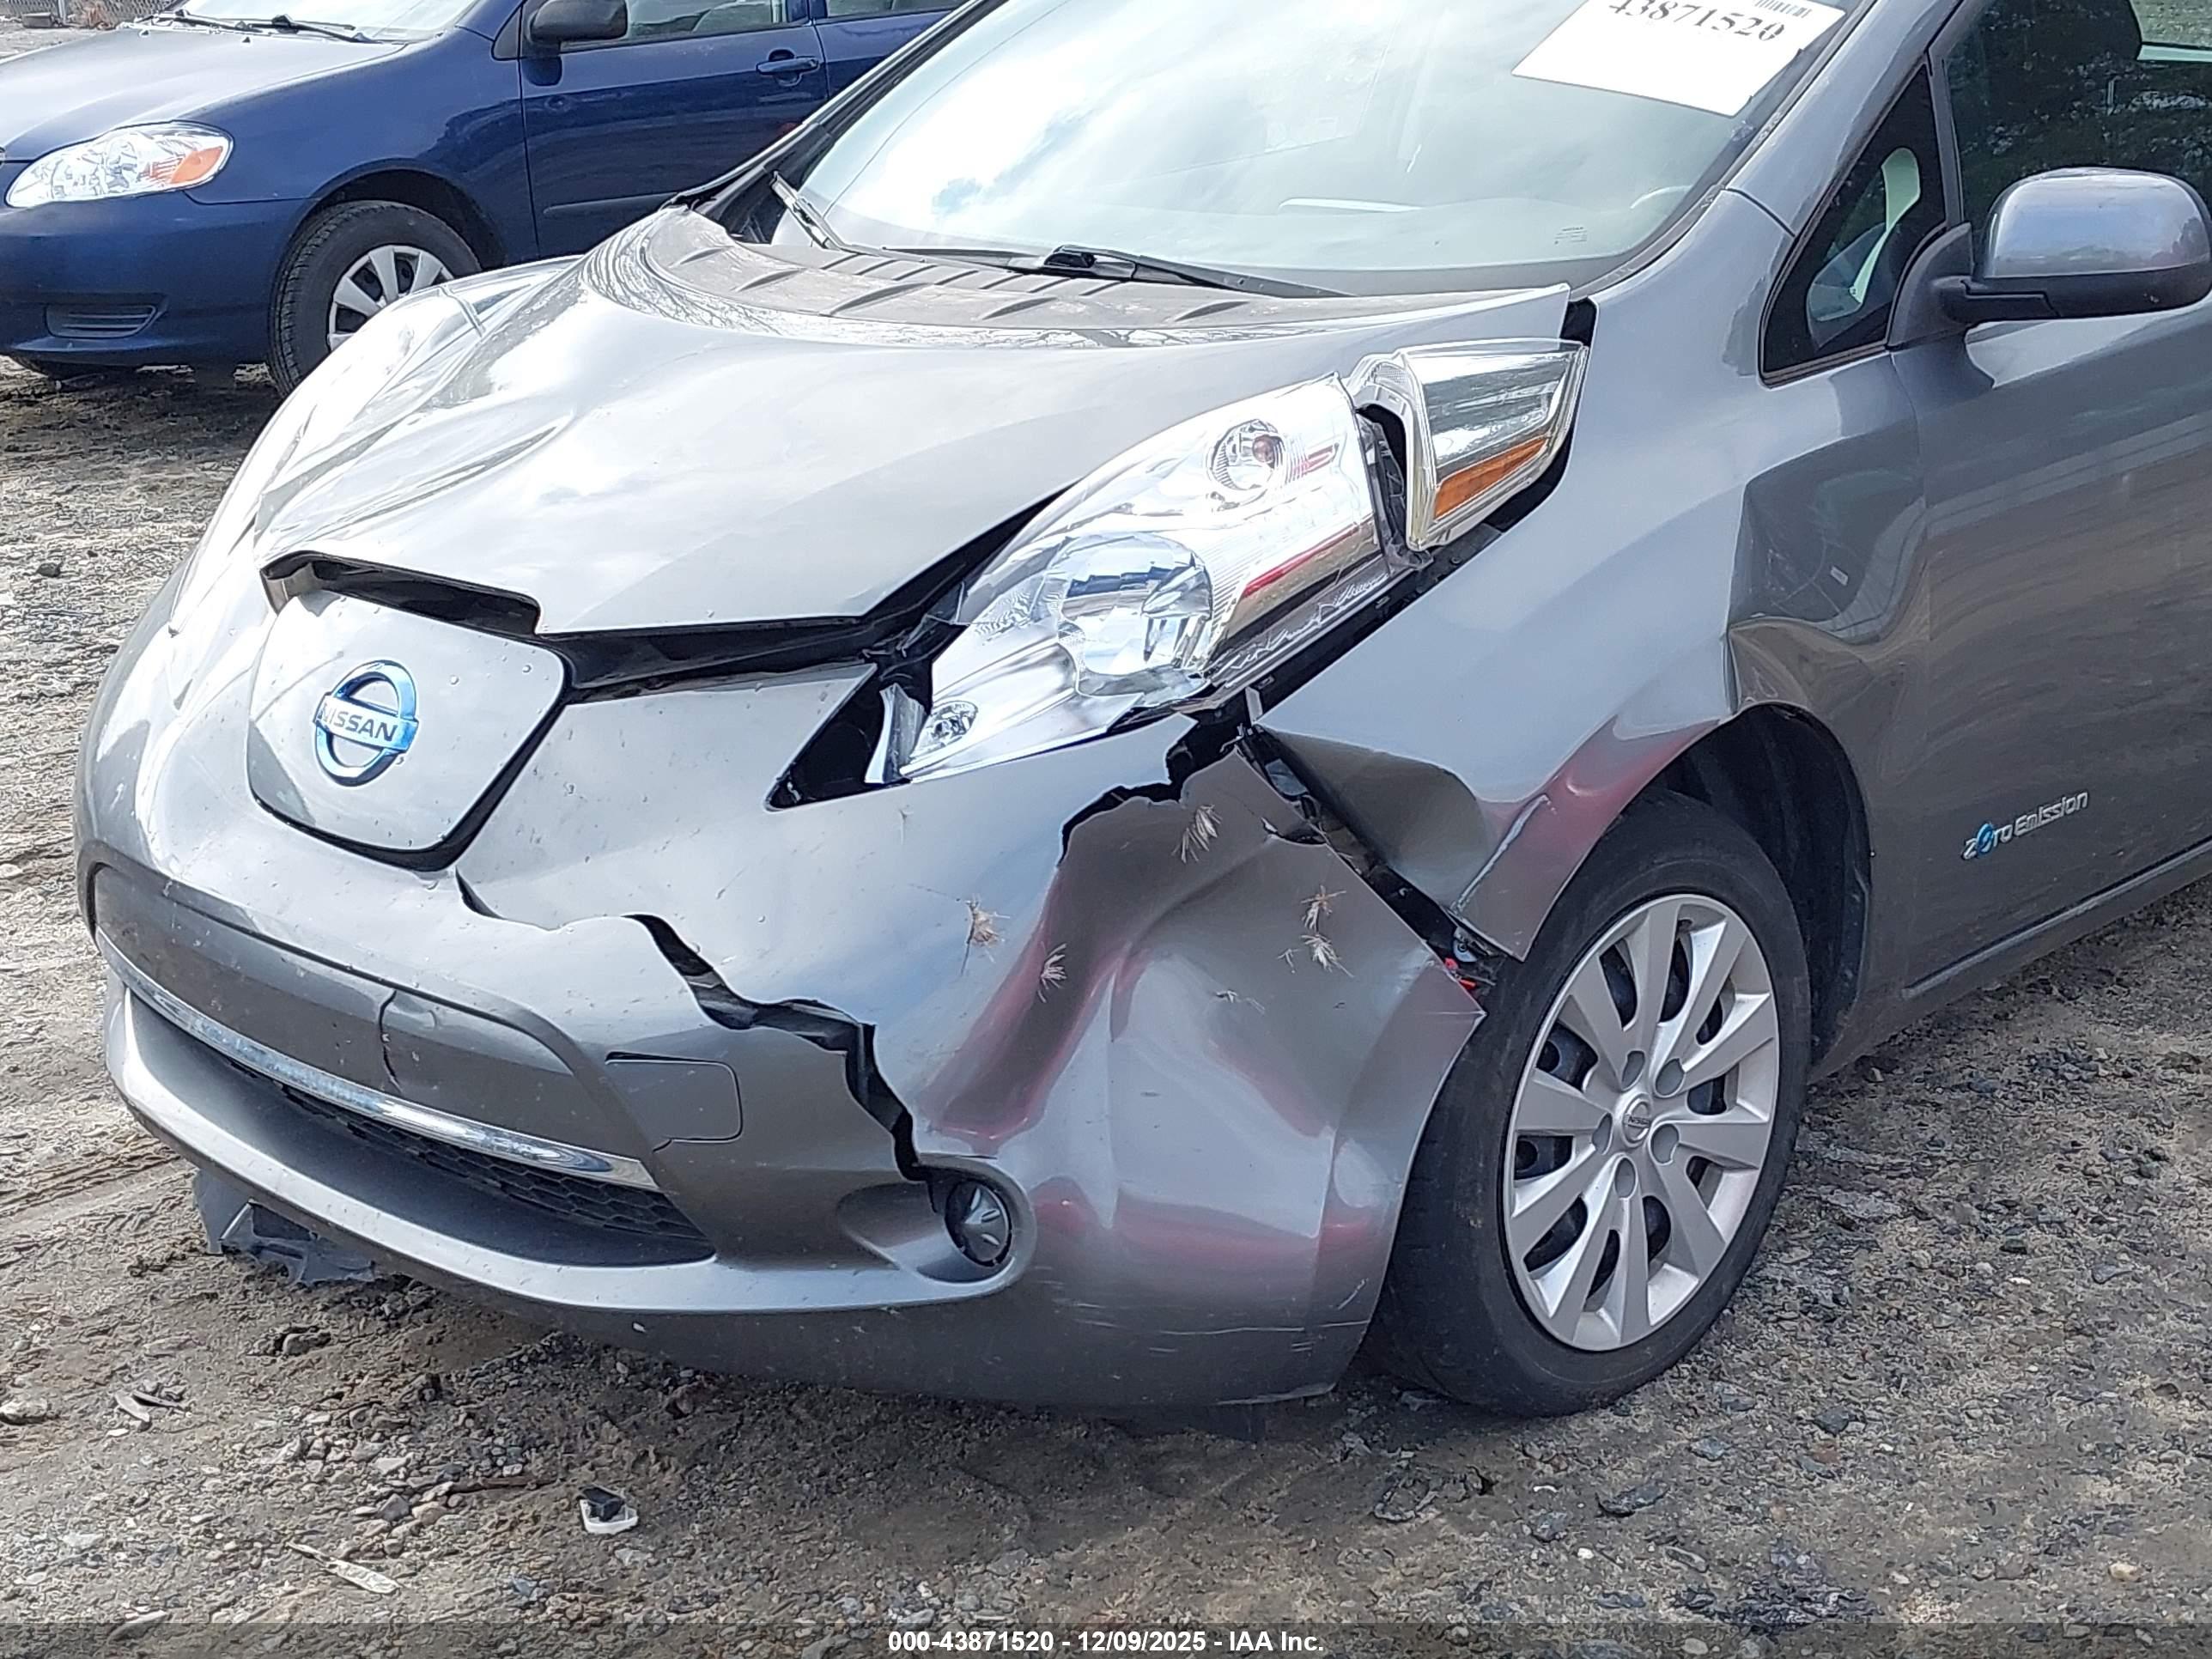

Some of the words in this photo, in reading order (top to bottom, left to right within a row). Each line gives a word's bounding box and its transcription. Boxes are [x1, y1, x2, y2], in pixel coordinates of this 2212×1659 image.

[1609, 0, 1785, 41] 43871520
[318, 702, 398, 742] NISSAN
[2014, 791, 2089, 836] Emission
